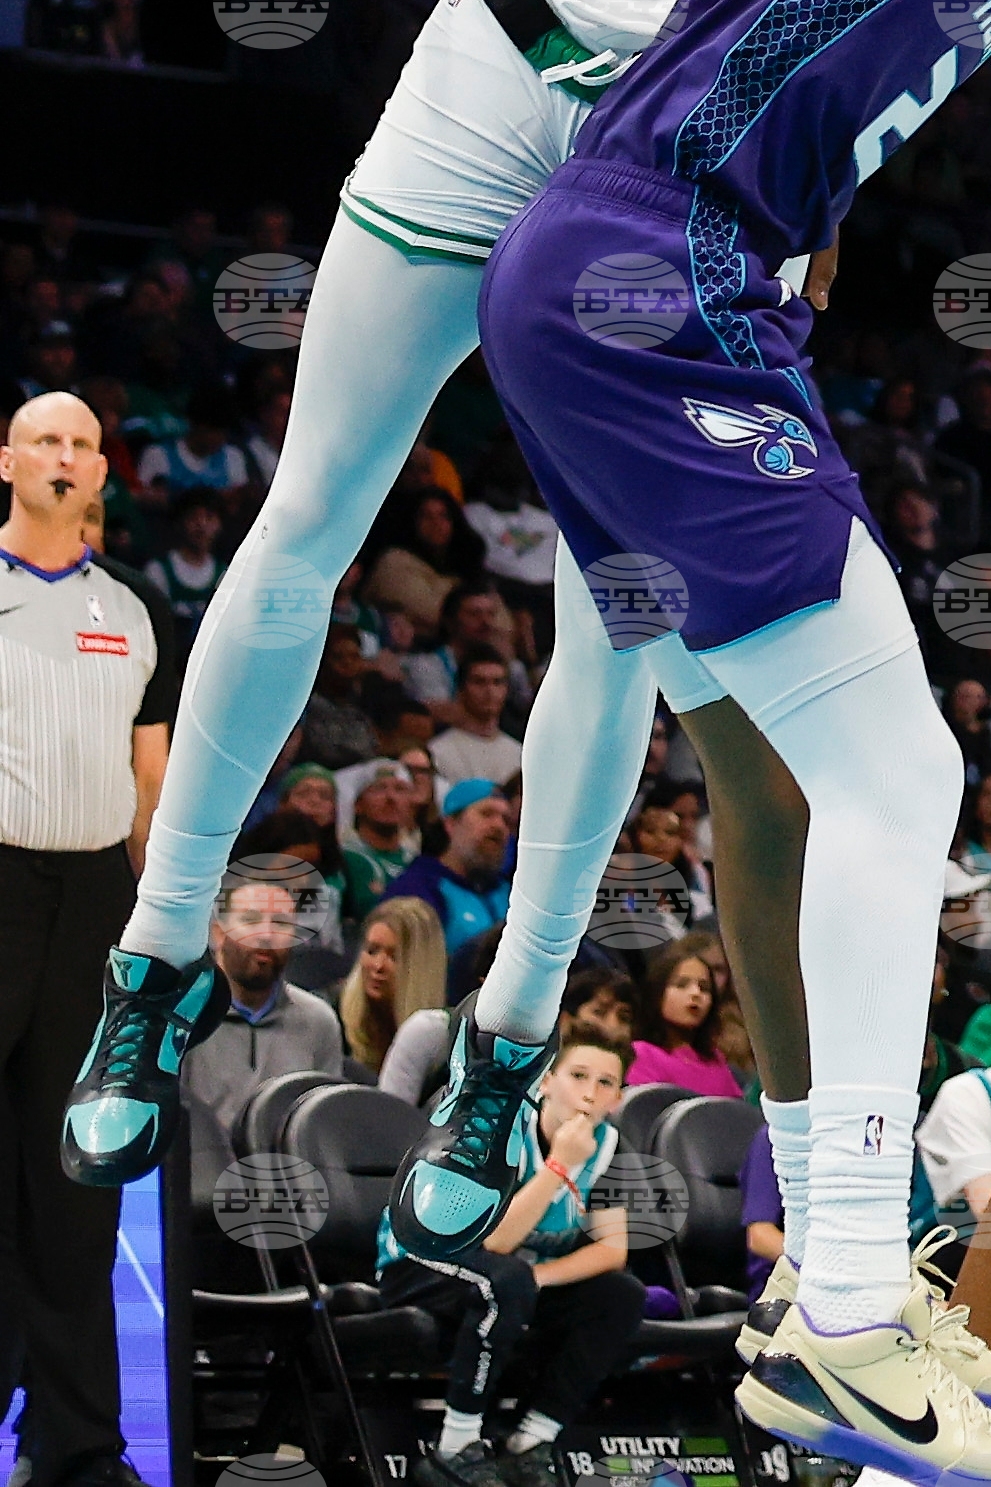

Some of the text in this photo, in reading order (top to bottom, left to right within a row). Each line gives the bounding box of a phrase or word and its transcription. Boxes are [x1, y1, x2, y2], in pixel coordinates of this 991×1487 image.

[600, 1436, 681, 1456] UTILITY
[384, 1454, 407, 1479] 17
[567, 1451, 595, 1476] 18
